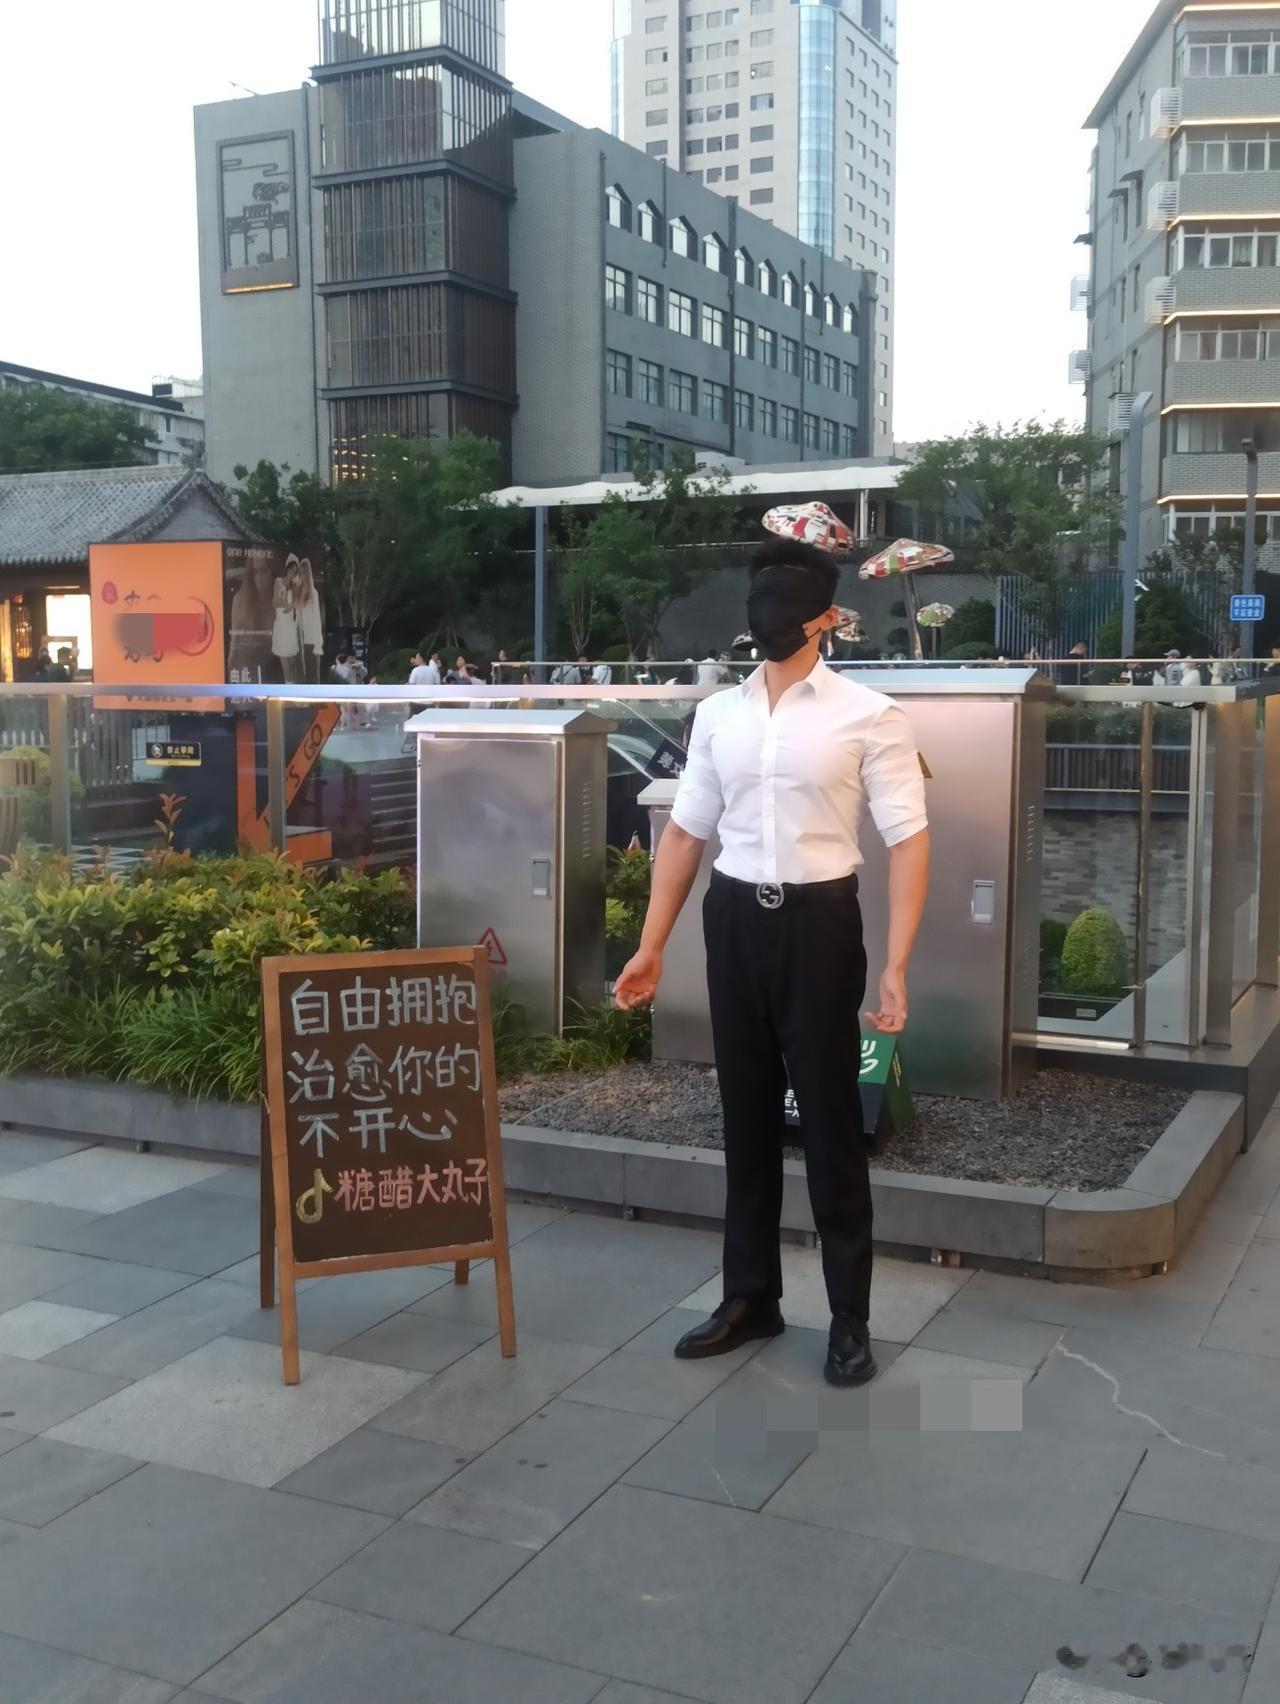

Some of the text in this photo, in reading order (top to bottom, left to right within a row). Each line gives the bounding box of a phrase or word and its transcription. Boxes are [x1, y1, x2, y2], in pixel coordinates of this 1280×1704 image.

[291, 974, 477, 1035] 自由拥抱
[286, 1042, 481, 1104] 治愈你的
[298, 1107, 458, 1158] 不开心
[334, 1158, 488, 1212] 糖醋大丸子
